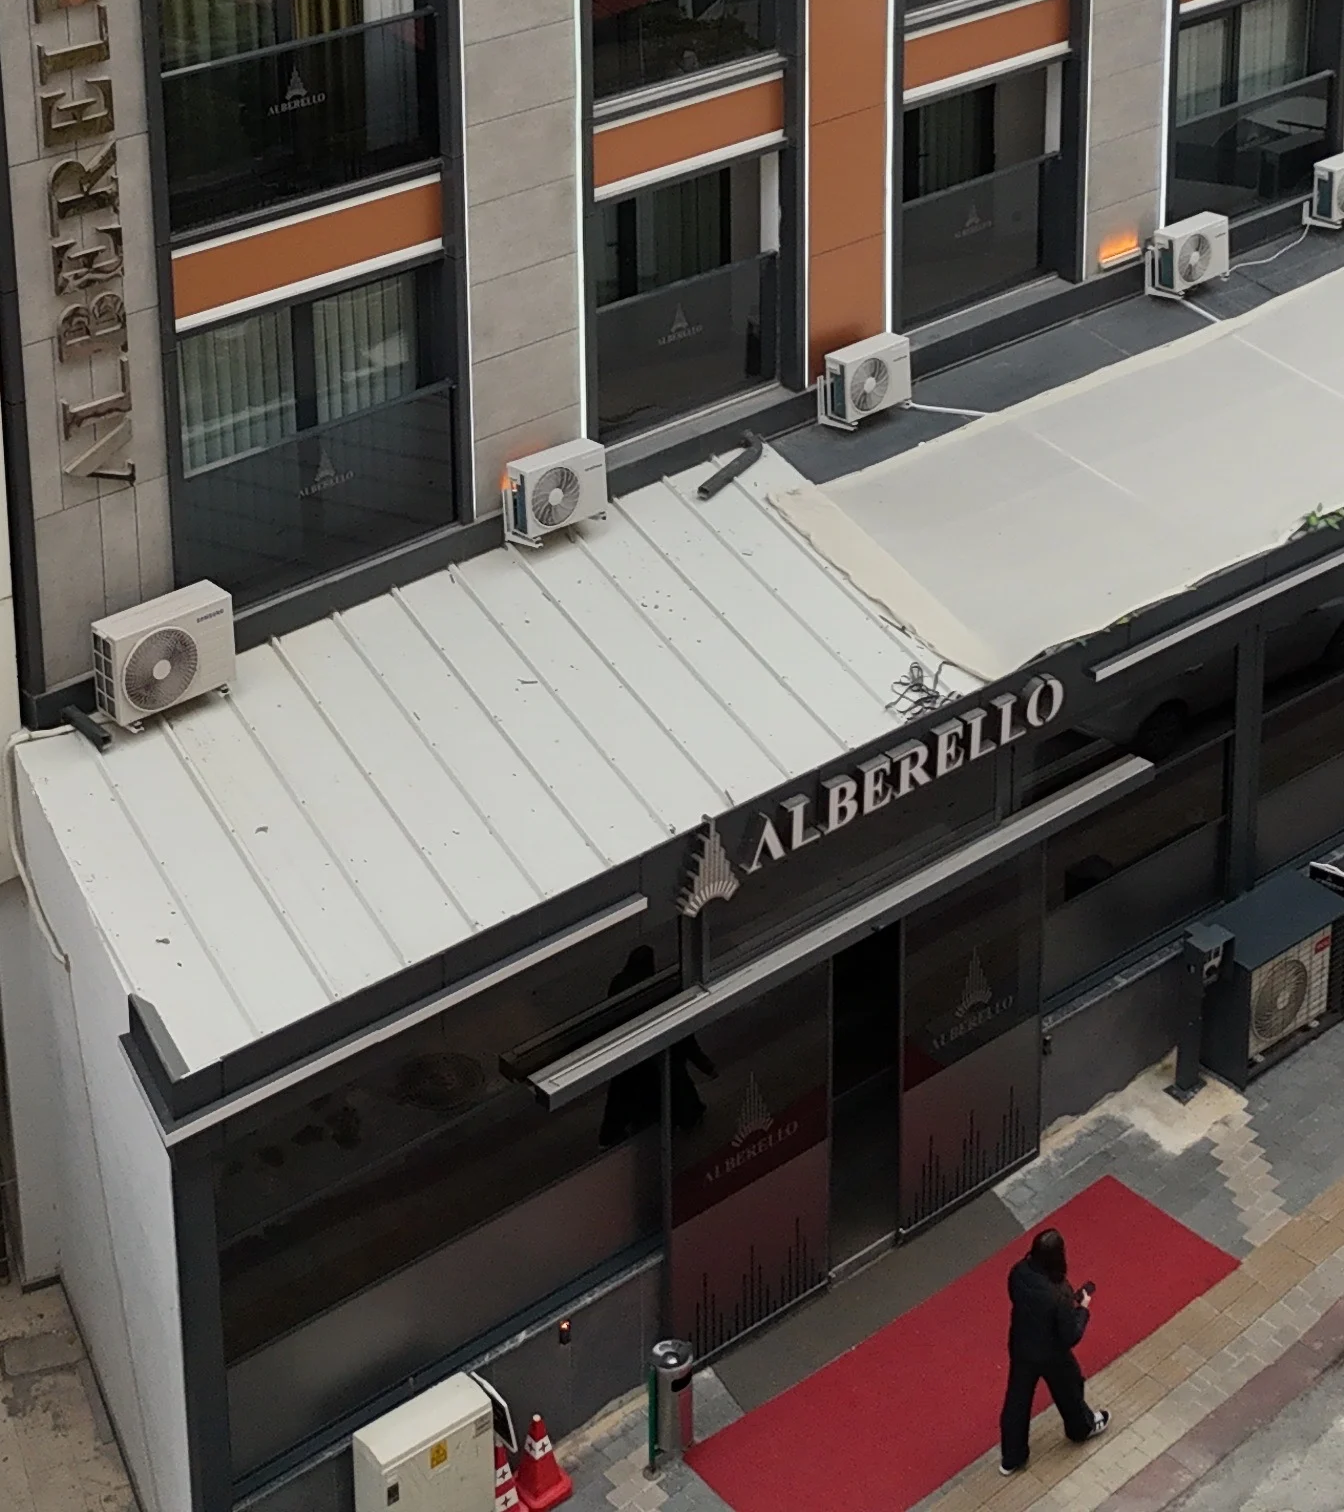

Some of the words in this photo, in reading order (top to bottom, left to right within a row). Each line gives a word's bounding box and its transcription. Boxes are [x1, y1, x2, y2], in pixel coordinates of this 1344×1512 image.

[268, 91, 327, 117] ALBERELLO
[738, 674, 1065, 875] ALBERELLO
[702, 1119, 800, 1186] ALBERELLO
